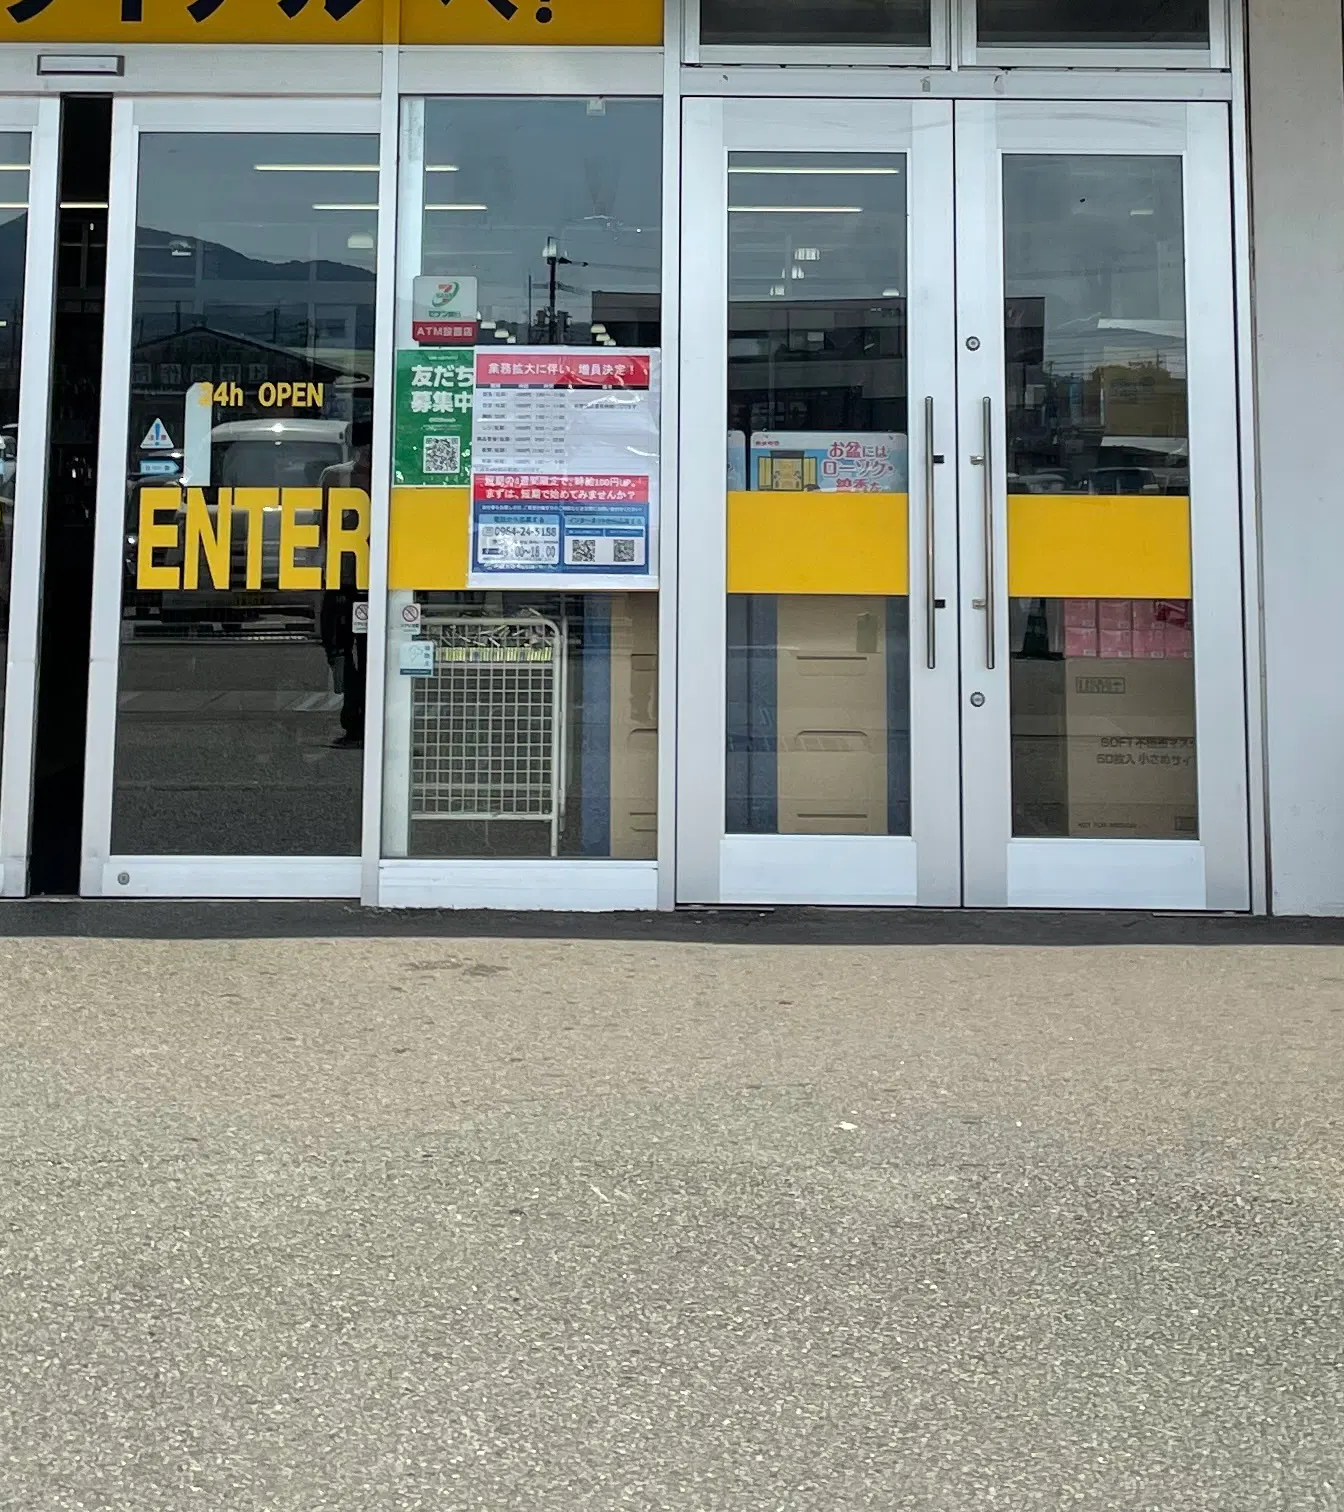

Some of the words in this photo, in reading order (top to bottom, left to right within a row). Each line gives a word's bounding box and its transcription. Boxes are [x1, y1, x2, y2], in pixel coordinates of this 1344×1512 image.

[416, 326, 473, 337] ATM設置店
[199, 382, 244, 407] 24h
[258, 382, 324, 408] OPEN
[411, 391, 474, 413] 募集中
[829, 441, 887, 458] お盆には
[136, 486, 370, 591] ENTER
